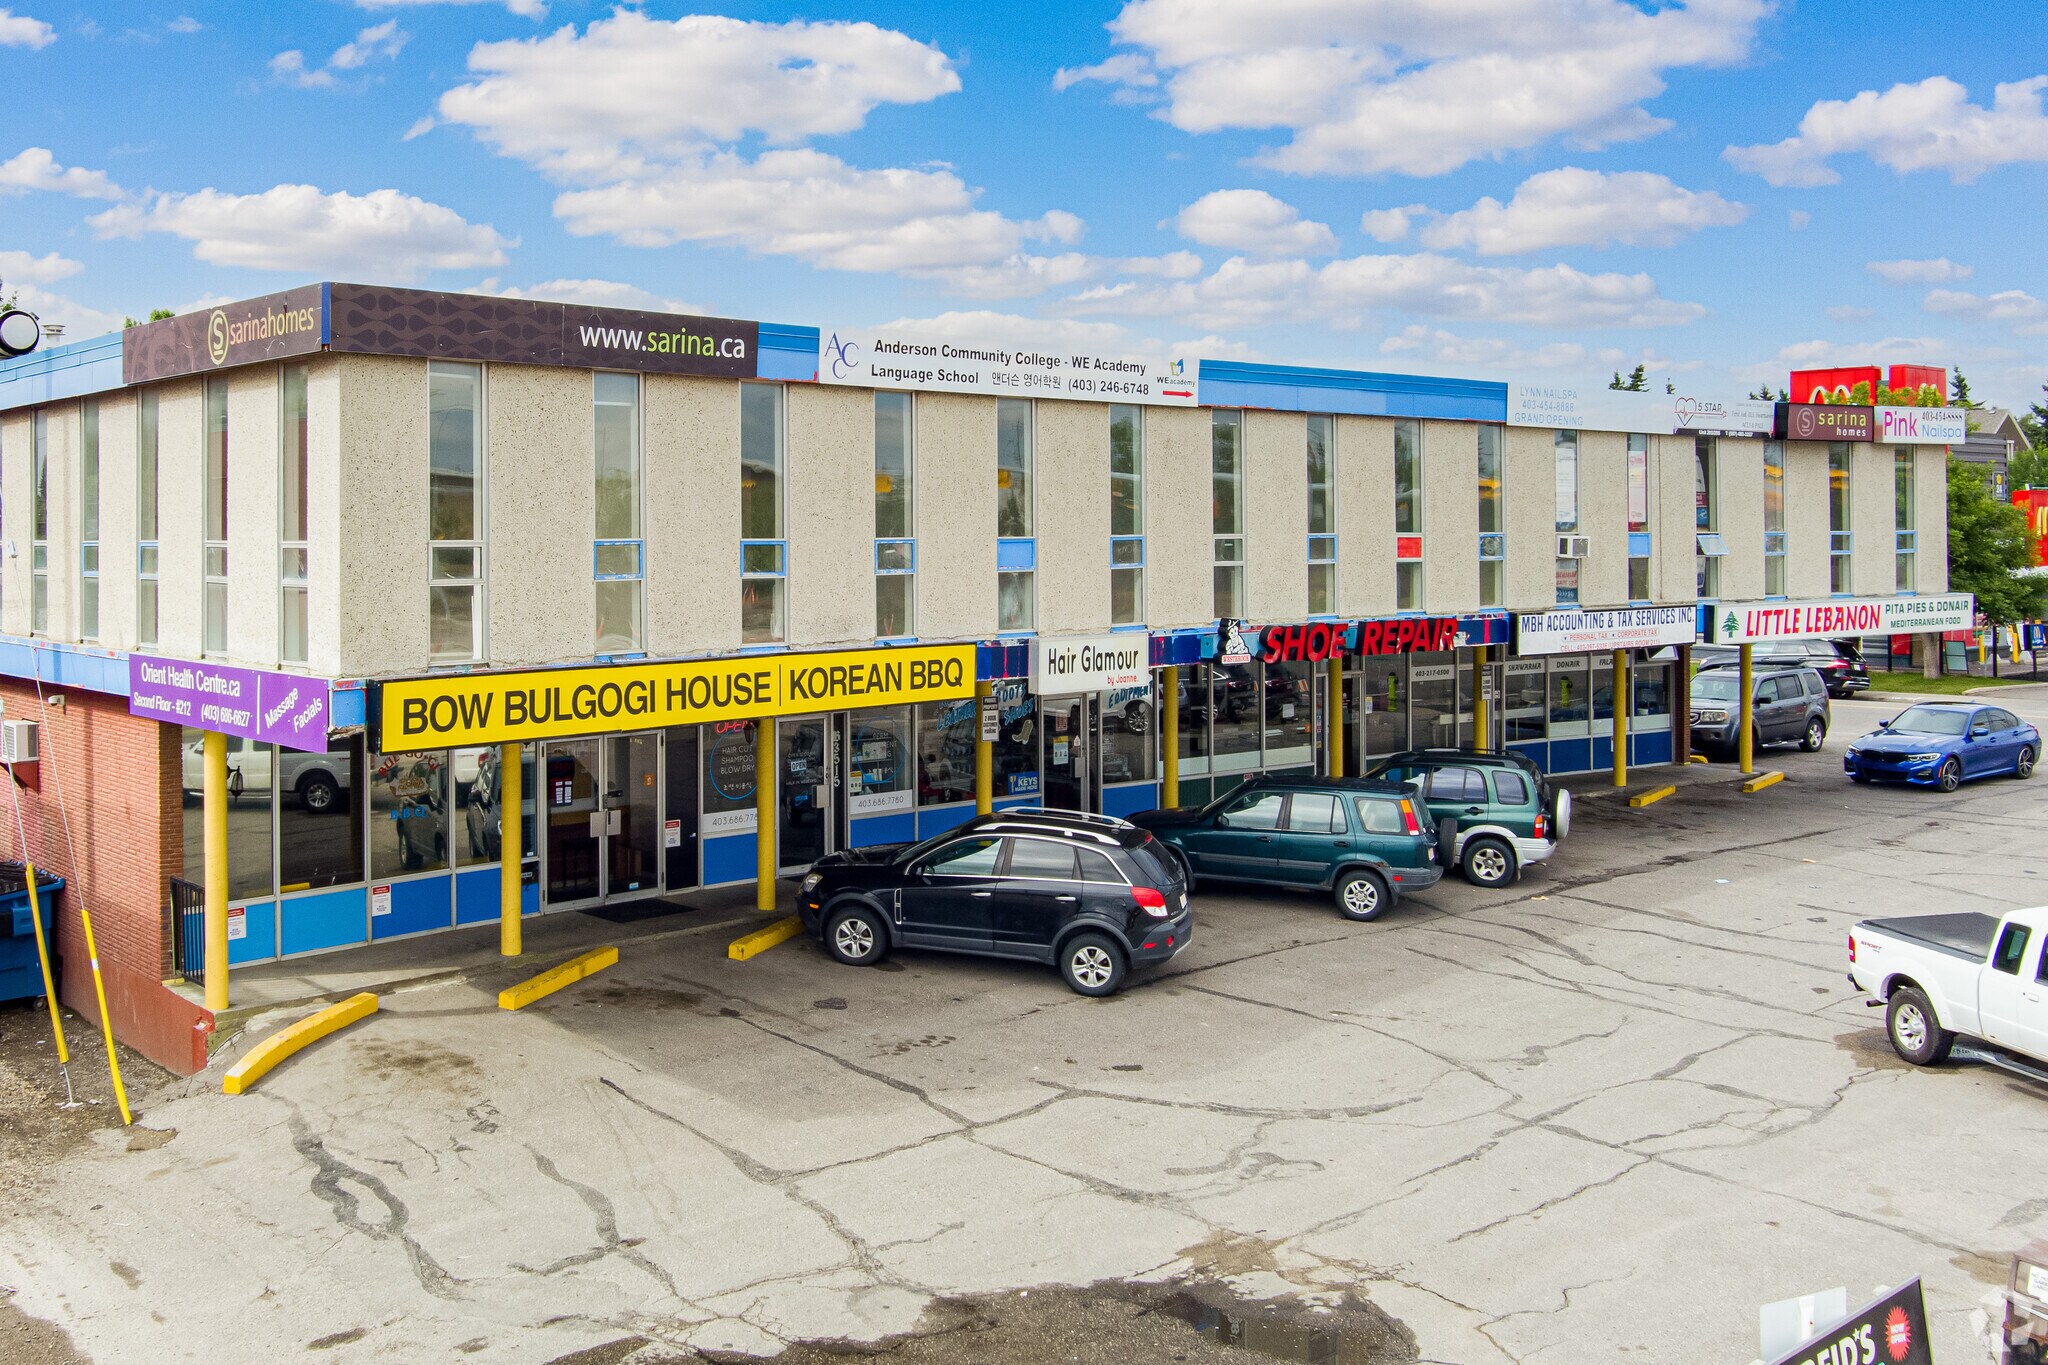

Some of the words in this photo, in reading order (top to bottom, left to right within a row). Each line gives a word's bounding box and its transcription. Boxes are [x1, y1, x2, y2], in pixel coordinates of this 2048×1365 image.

[229, 306, 314, 346] sarinahomes
[579, 325, 746, 359] www.sarina.ca
[874, 339, 938, 357] Anderson
[941, 345, 1012, 366] Community
[1015, 350, 1061, 369] College
[1071, 356, 1090, 370] WE
[1093, 357, 1147, 376] Academy
[870, 364, 933, 383] Language
[937, 367, 979, 384] School
[991, 372, 1020, 387] 앤더슨
[1023, 373, 1061, 389] 영어학원
[1068, 378, 1097, 394] (403)
[1100, 381, 1149, 395] 246-6748
[1519, 386, 1542, 398] LYNN
[1543, 388, 1578, 400] NAILSPA
[1697, 402, 1703, 412] 5
[1704, 403, 1722, 412] STAR
[1514, 412, 1545, 424] GRAND
[1546, 414, 1584, 426] OPENING
[1818, 410, 1867, 426] sarina
[1884, 411, 1918, 437] Pink
[1836, 426, 1866, 437] homes
[1922, 424, 1962, 440] Nailspa
[1885, 602, 1905, 615] PITA
[1906, 601, 1926, 613] PIES
[1928, 601, 1934, 612] &
[1936, 600, 1969, 612] DONAIR
[1521, 615, 1544, 633] MBH
[1546, 612, 1605, 632] ACCOUNTING
[1607, 613, 1614, 628] &
[1617, 610, 1633, 627] TAX
[1635, 608, 1676, 627] SERVICES
[1678, 606, 1695, 625] INC.
[1746, 607, 1801, 637] LITTLE
[1805, 603, 1881, 633] LEBANON
[1890, 618, 1944, 629] MEDITERRANEAN
[1945, 616, 1961, 626] FOOD
[1258, 622, 1350, 664] SHOE
[1360, 617, 1459, 656] REPAIR
[1047, 647, 1077, 676] Hair
[1081, 645, 1139, 673] Glamour
[1222, 655, 1250, 663] WESTBROOK
[1507, 662, 1542, 672] SHAWARMA
[1556, 660, 1581, 669] DONAIR
[1598, 658, 1614, 667] FALA
[141, 661, 167, 684] Orient
[168, 665, 195, 690] Health
[195, 670, 241, 698] Centre.ca
[1106, 676, 1114, 686] by
[402, 693, 494, 735] BOW
[504, 677, 657, 726] BULGOGI
[666, 671, 771, 711] HOUSE
[788, 663, 903, 702] KOREAN
[909, 657, 964, 689] BBQ
[1108, 680, 1153, 709] EQUIPMENT
[133, 691, 155, 711] Second
[155, 697, 172, 713] Floor
[175, 701, 192, 717] #212
[264, 687, 299, 729] Massage
[1003, 698, 1034, 726] SHOES
[200, 703, 220, 726] (403)
[220, 706, 251, 728] 686-6627
[293, 696, 323, 734] Facials
[937, 701, 977, 732] LEATHER
[722, 746, 737, 755] HAIR
[738, 744, 753, 753] CUT
[721, 755, 754, 765] SHAMPOO
[791, 762, 806, 770] OPEN
[720, 766, 740, 775] BLOW
[742, 764, 755, 773] DRY
[1017, 776, 1038, 787] KEYS
[712, 813, 758, 826] 403.686.778
[1800, 1323, 1877, 1365] ID'S
